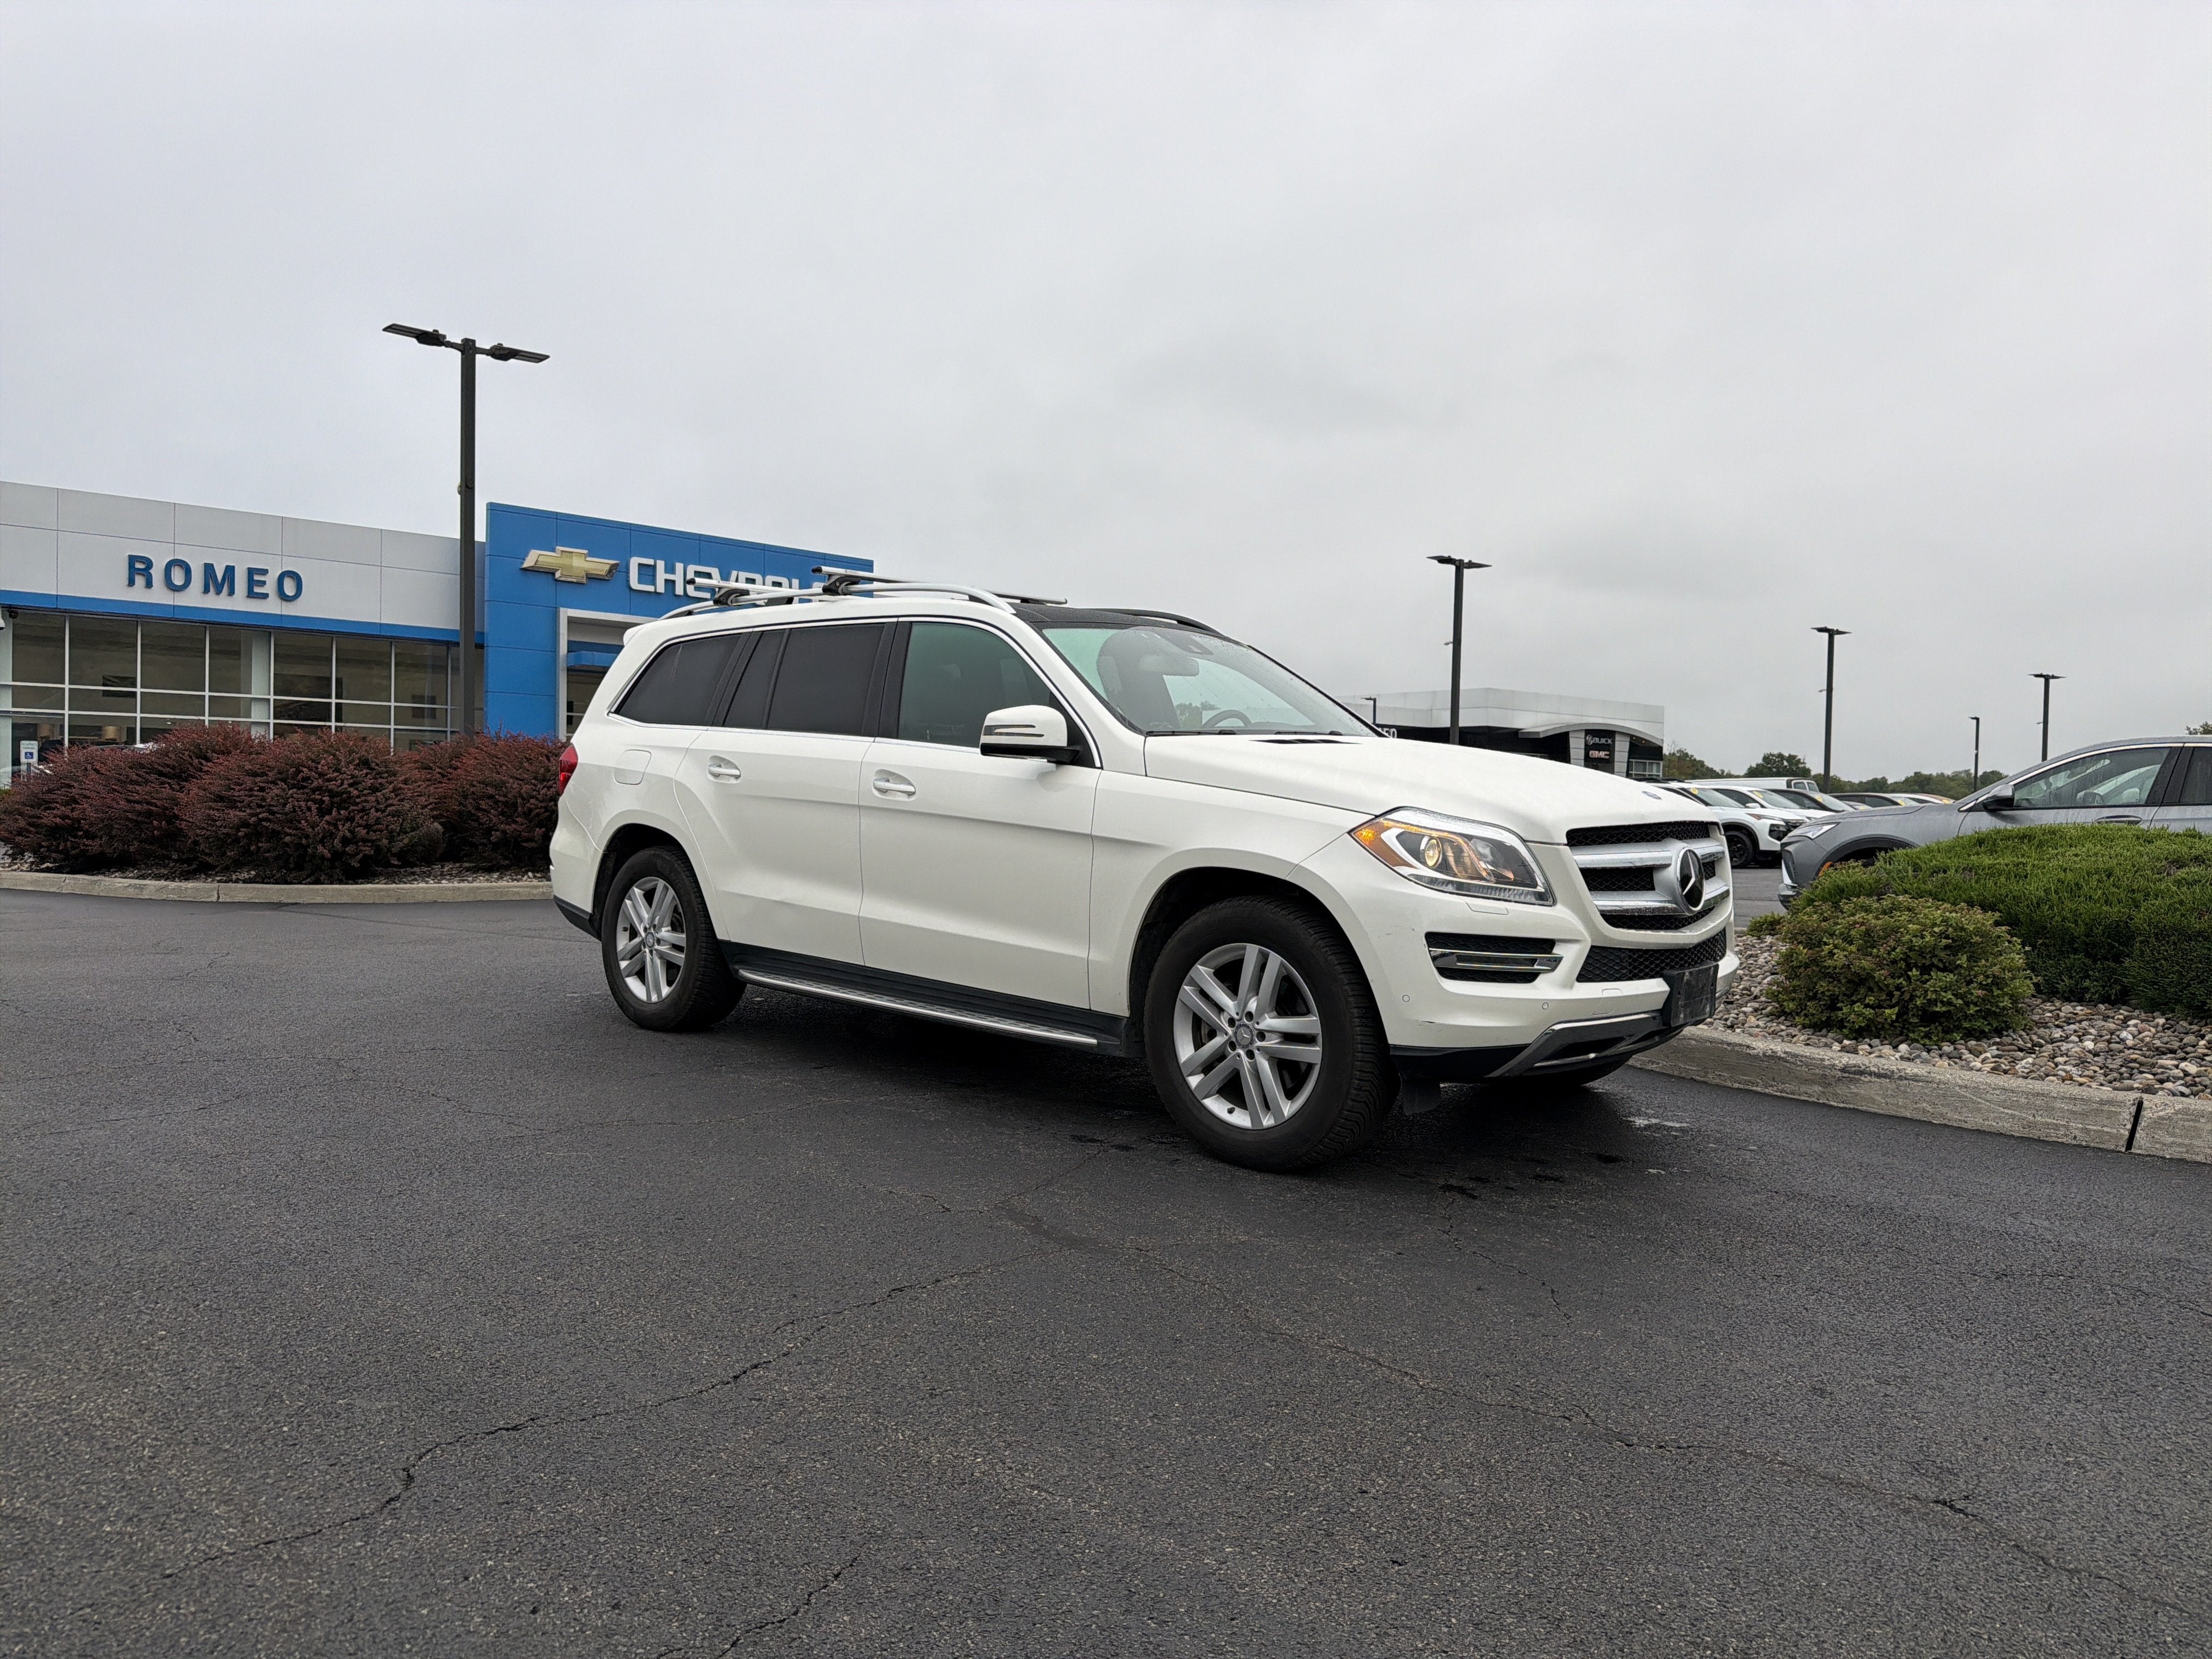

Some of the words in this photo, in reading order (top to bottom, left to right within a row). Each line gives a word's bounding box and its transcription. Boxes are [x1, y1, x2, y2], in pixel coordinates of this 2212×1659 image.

[128, 554, 303, 602] ROMEO
[630, 556, 824, 605] CHEVRO
[1589, 750, 1610, 759] GMC
